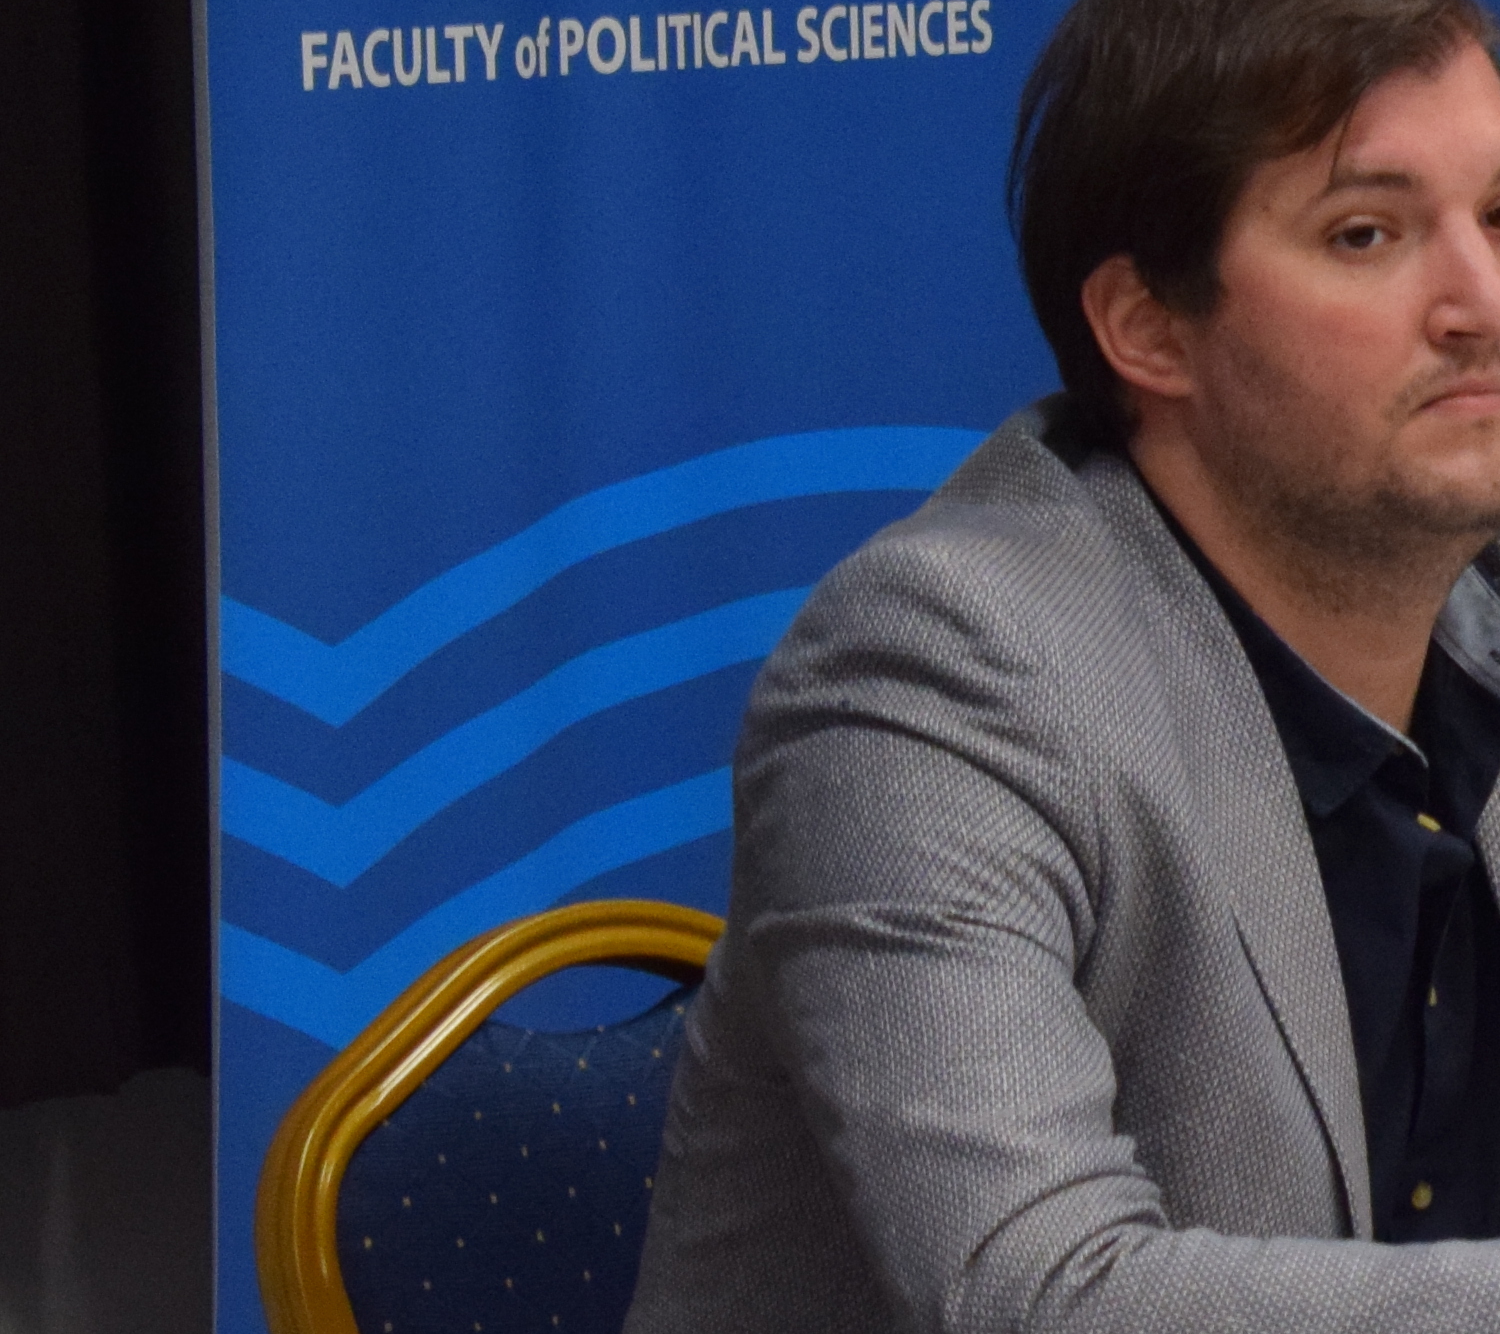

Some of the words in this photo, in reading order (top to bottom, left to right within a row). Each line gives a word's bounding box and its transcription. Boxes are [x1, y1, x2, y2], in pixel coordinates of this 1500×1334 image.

[300, 22, 504, 91] FACULTY
[515, 16, 550, 79] of
[560, 7, 785, 76] POLITICAL
